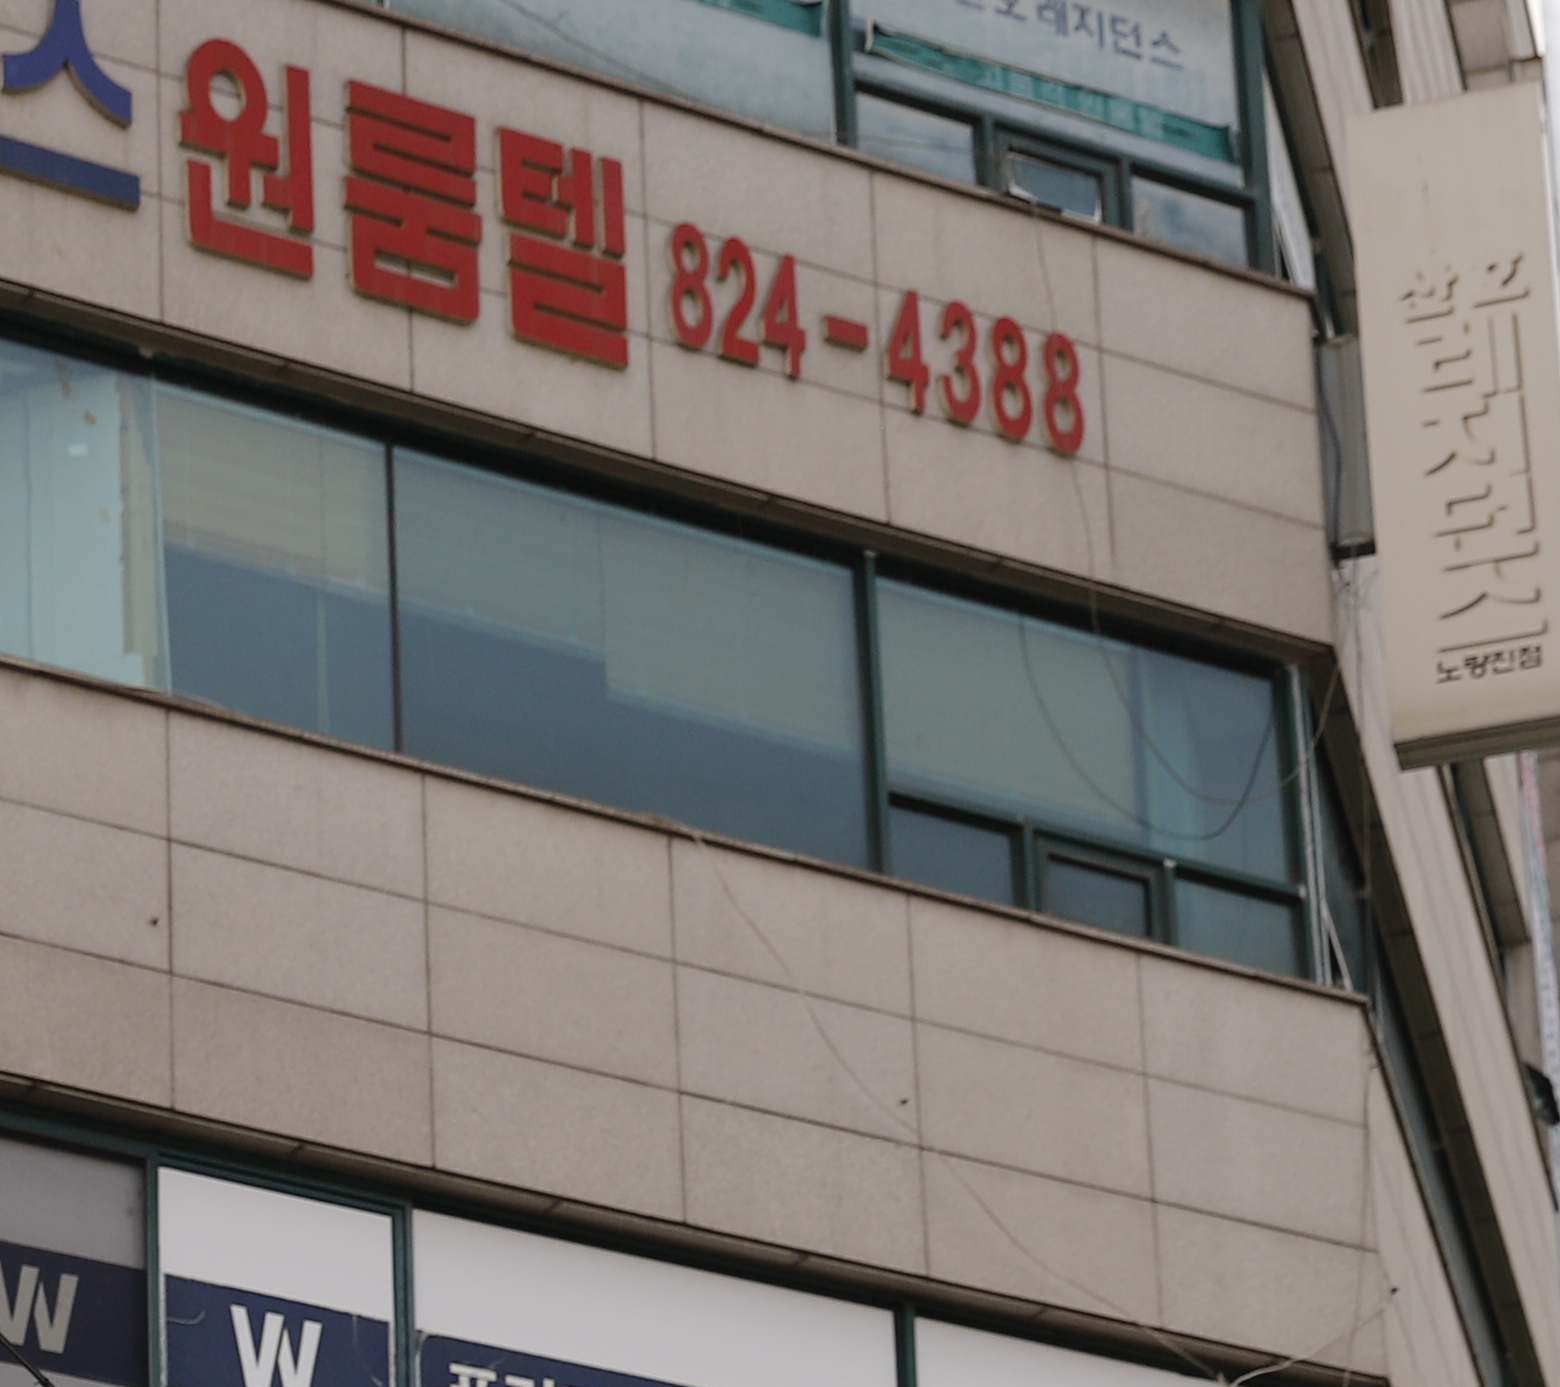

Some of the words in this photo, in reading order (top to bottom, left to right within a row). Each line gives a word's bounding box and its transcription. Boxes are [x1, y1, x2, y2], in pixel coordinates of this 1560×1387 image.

[180, 37, 628, 369] 원룸텔
[669, 222, 1086, 457] 824-4388
[1435, 644, 1543, 686] 노량진점
